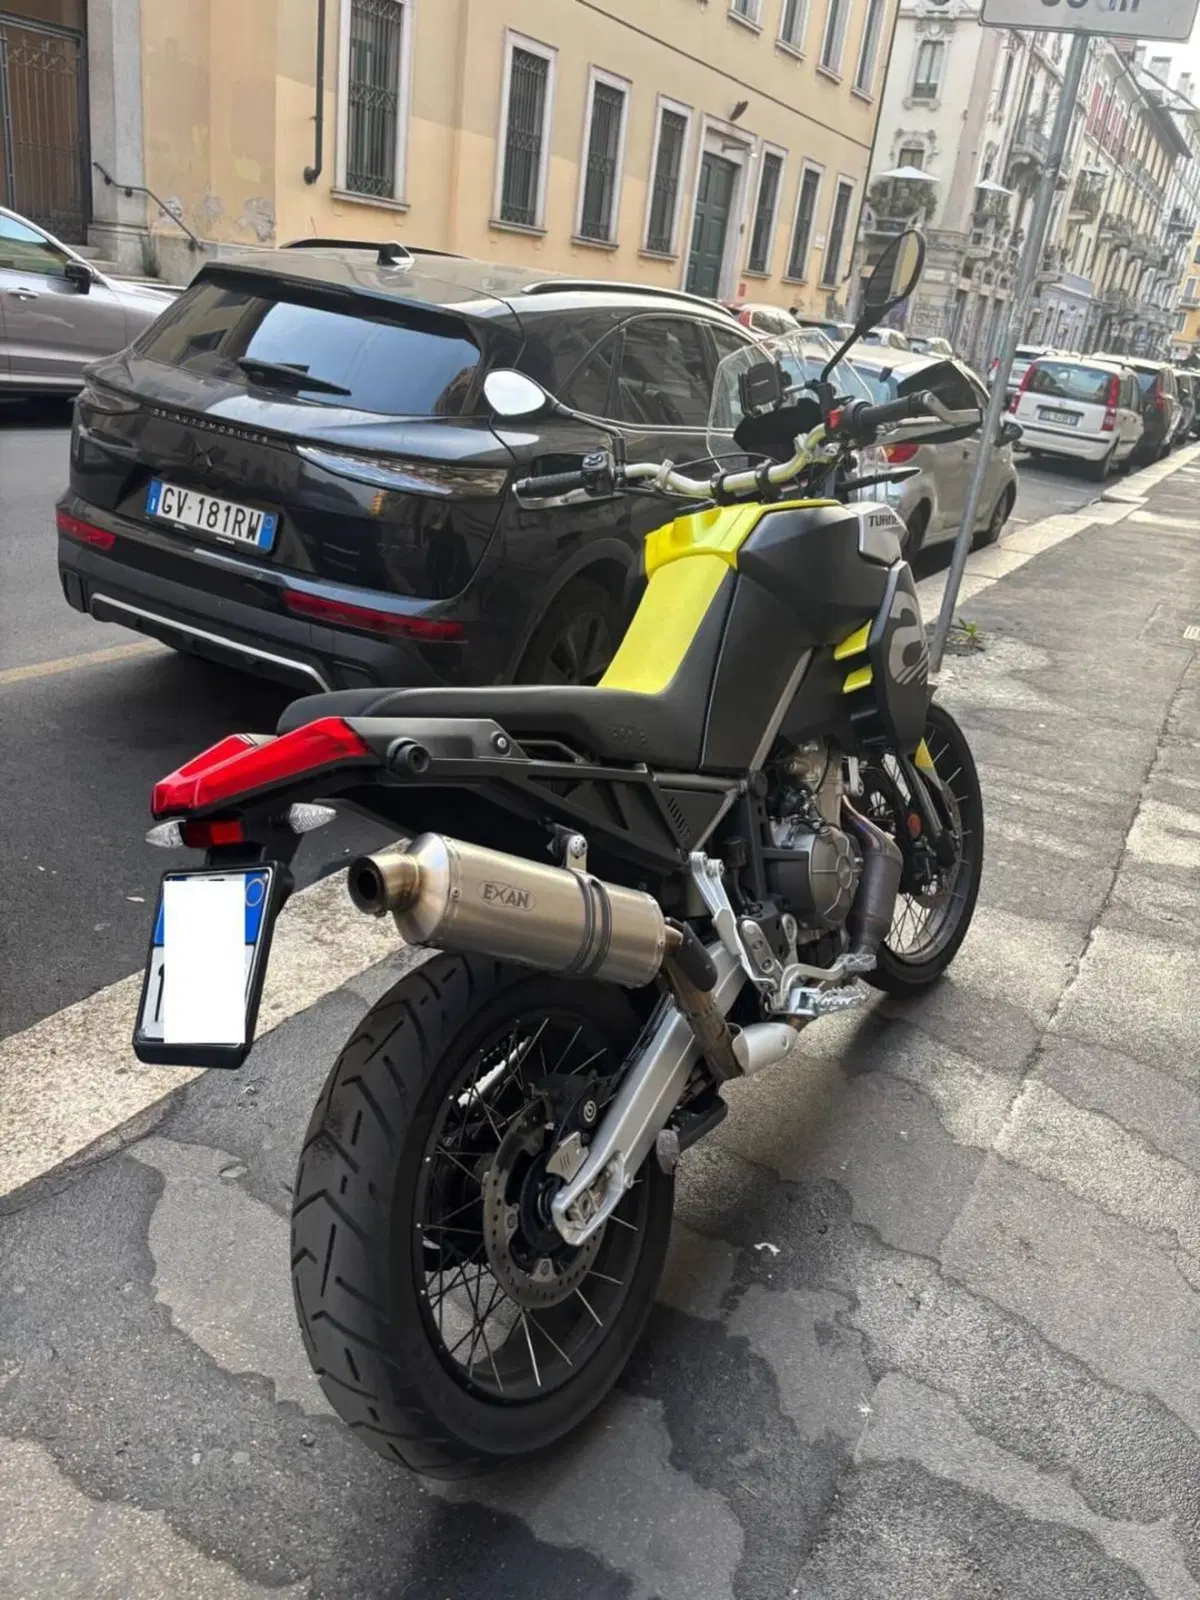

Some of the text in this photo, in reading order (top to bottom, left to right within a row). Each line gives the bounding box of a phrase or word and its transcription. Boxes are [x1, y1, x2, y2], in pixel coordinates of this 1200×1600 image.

[161, 487, 261, 541] GV 181RW
[483, 884, 530, 909] EXAN
